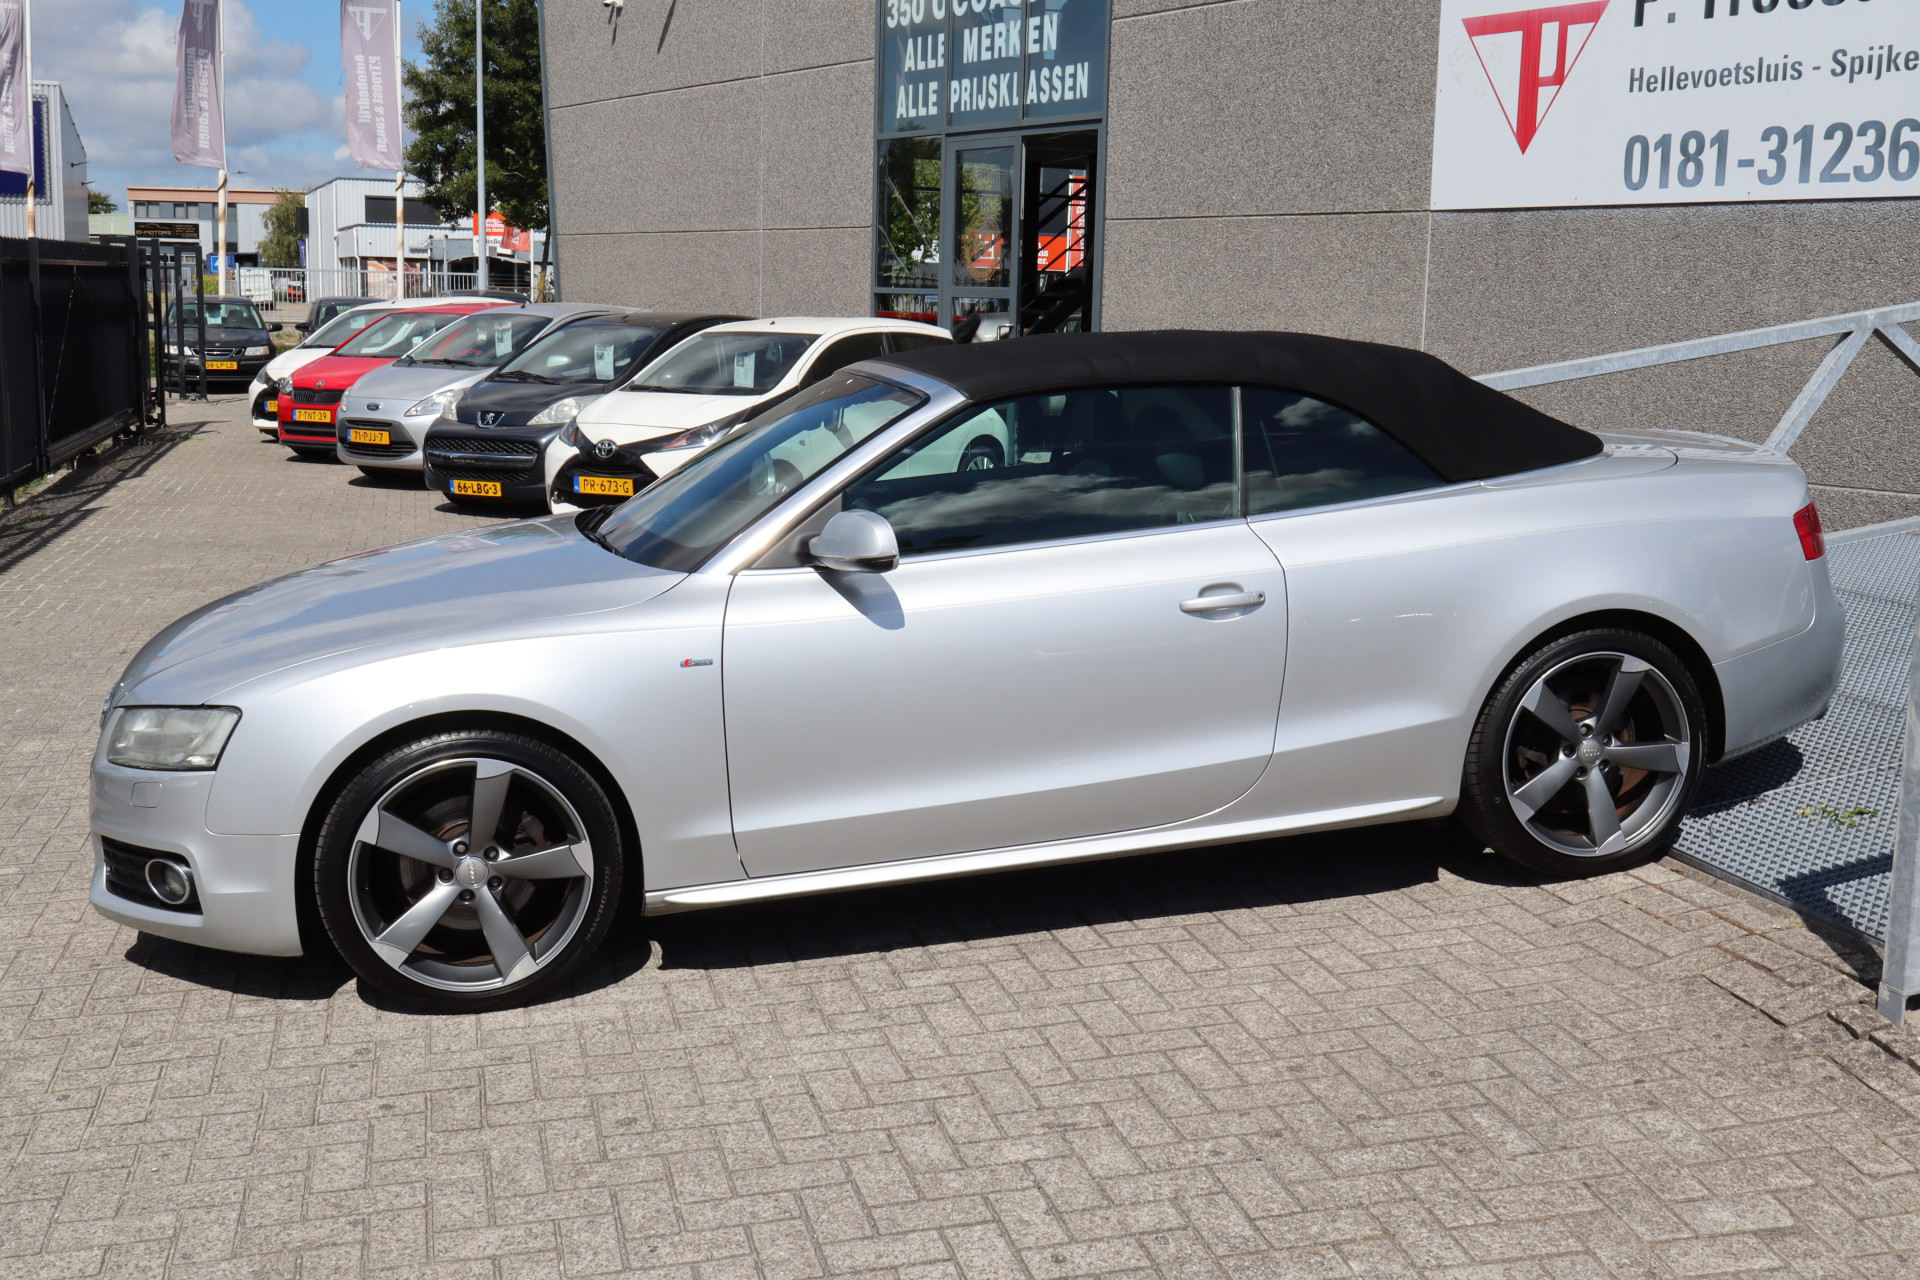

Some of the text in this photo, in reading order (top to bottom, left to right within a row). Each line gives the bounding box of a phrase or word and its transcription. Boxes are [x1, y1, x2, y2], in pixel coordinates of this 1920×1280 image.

[904, 14, 1058, 72] ALLE MERKEN
[1628, 54, 1803, 93] Hellevoetsluis
[1830, 44, 1920, 84] Spijke
[896, 81, 938, 119] ALLE
[1623, 118, 1920, 191] 0181-31236
[298, 411, 327, 421] 7-TNT-39
[354, 431, 384, 442] 71-PJJ-7
[457, 482, 498, 495] 66-LBG-3
[583, 479, 630, 493] PR-673-G
